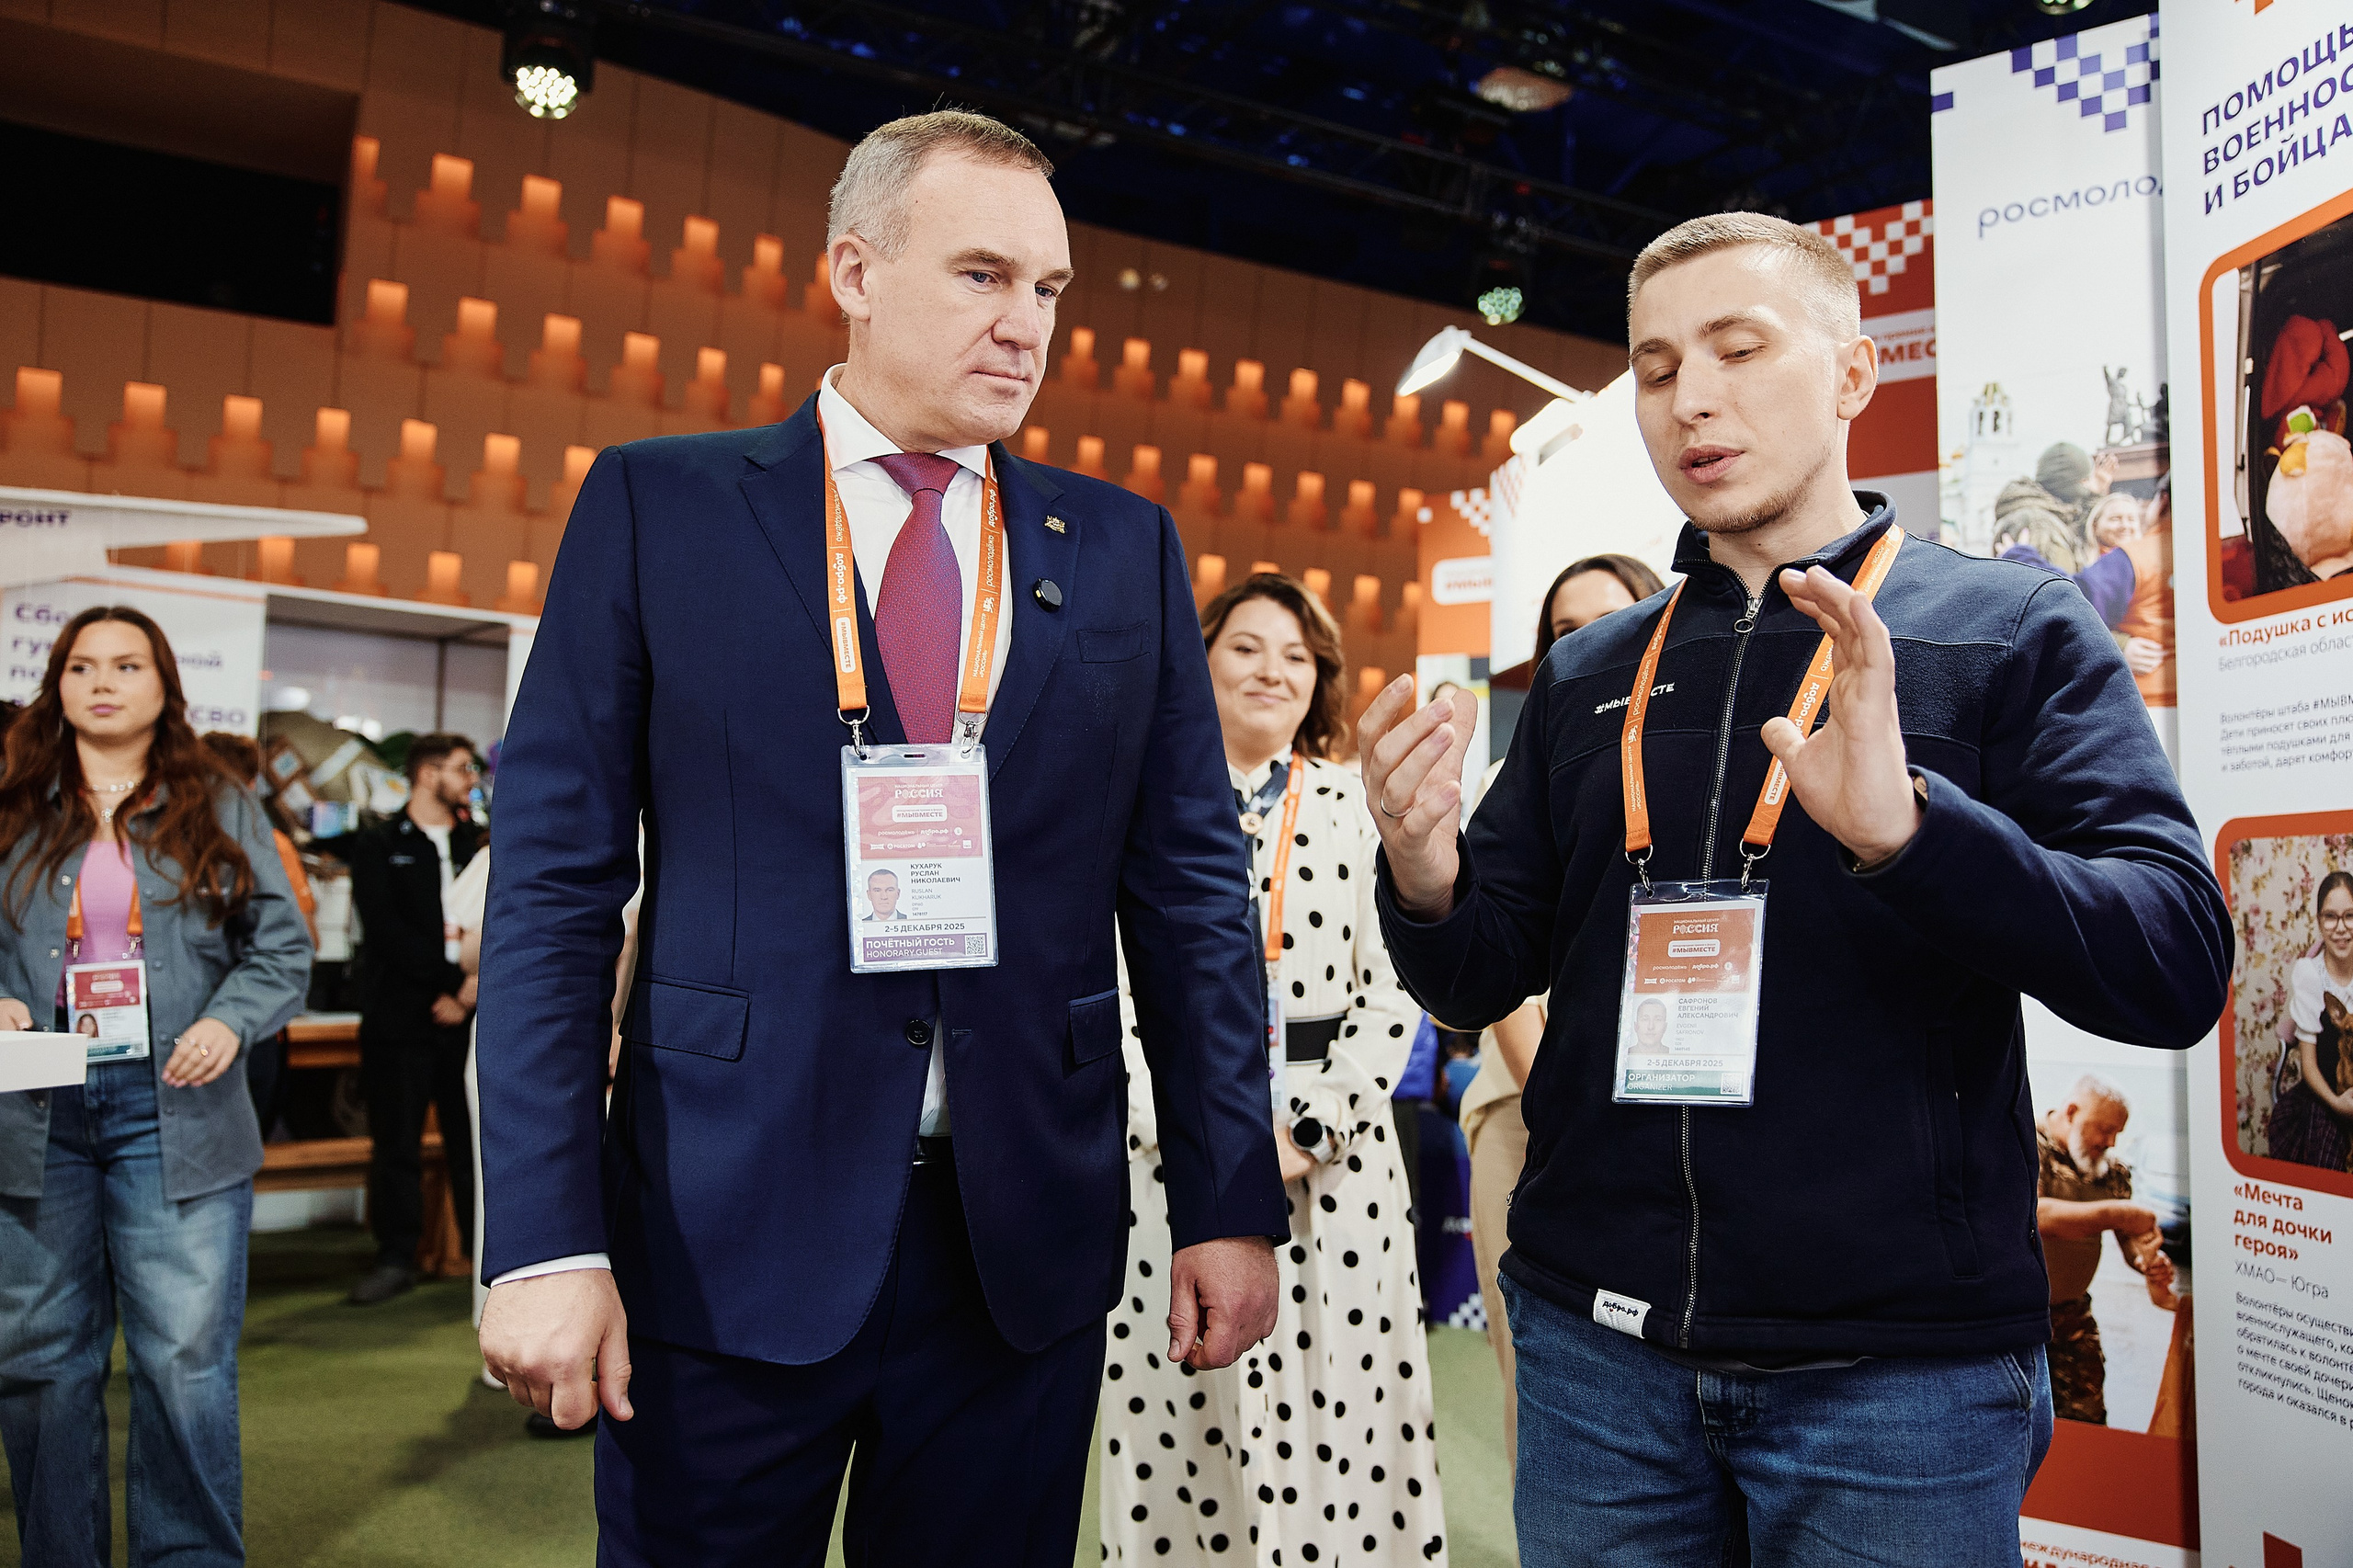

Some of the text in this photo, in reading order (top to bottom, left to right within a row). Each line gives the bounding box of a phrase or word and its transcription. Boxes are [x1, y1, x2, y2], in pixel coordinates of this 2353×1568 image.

[1979, 175, 2163, 240] росмоло
[2204, 183, 2223, 216] И
[840, 621, 852, 669] #МЫВМЕСТЕ
[2218, 617, 2312, 648] «Подушка
[2316, 614, 2327, 628] с
[2218, 634, 2353, 673] Белгородская облас
[1795, 681, 1821, 736] добро.р
[2329, 732, 2351, 745] для
[894, 789, 944, 799] РОССИЯ
[884, 923, 965, 933] 2-5 ДЕКАБРЯ 2025
[1672, 923, 1719, 935] РОССИЯ
[866, 937, 955, 949] ПОЧЁТНЫЙ ГОСТЬ
[866, 948, 943, 958] HONORARY GUEST
[1678, 1004, 1710, 1012] ЕВГЕНИЙ
[1628, 1073, 1696, 1083] ОРГАНИЗАТОР
[1661, 1060, 1701, 1068] ДЕКАБРЯ
[1627, 1082, 1673, 1091] ORGANIZER
[2234, 1182, 2304, 1211] «Мечта
[2233, 1209, 2333, 1245] для дочки
[2234, 1233, 2300, 1261] героя»
[2290, 1273, 2329, 1301] Югра
[2235, 1326, 2298, 1356] обратилась
[2300, 1347, 2306, 1358] к
[2236, 1344, 2245, 1355] о
[2245, 1347, 2277, 1367] мечте
[2279, 1358, 2311, 1378] своей
[2237, 1378, 2275, 1400] города
[2277, 1392, 2284, 1403] и
[2286, 1395, 2337, 1423] оказался
[2339, 1415, 2347, 1426] в
